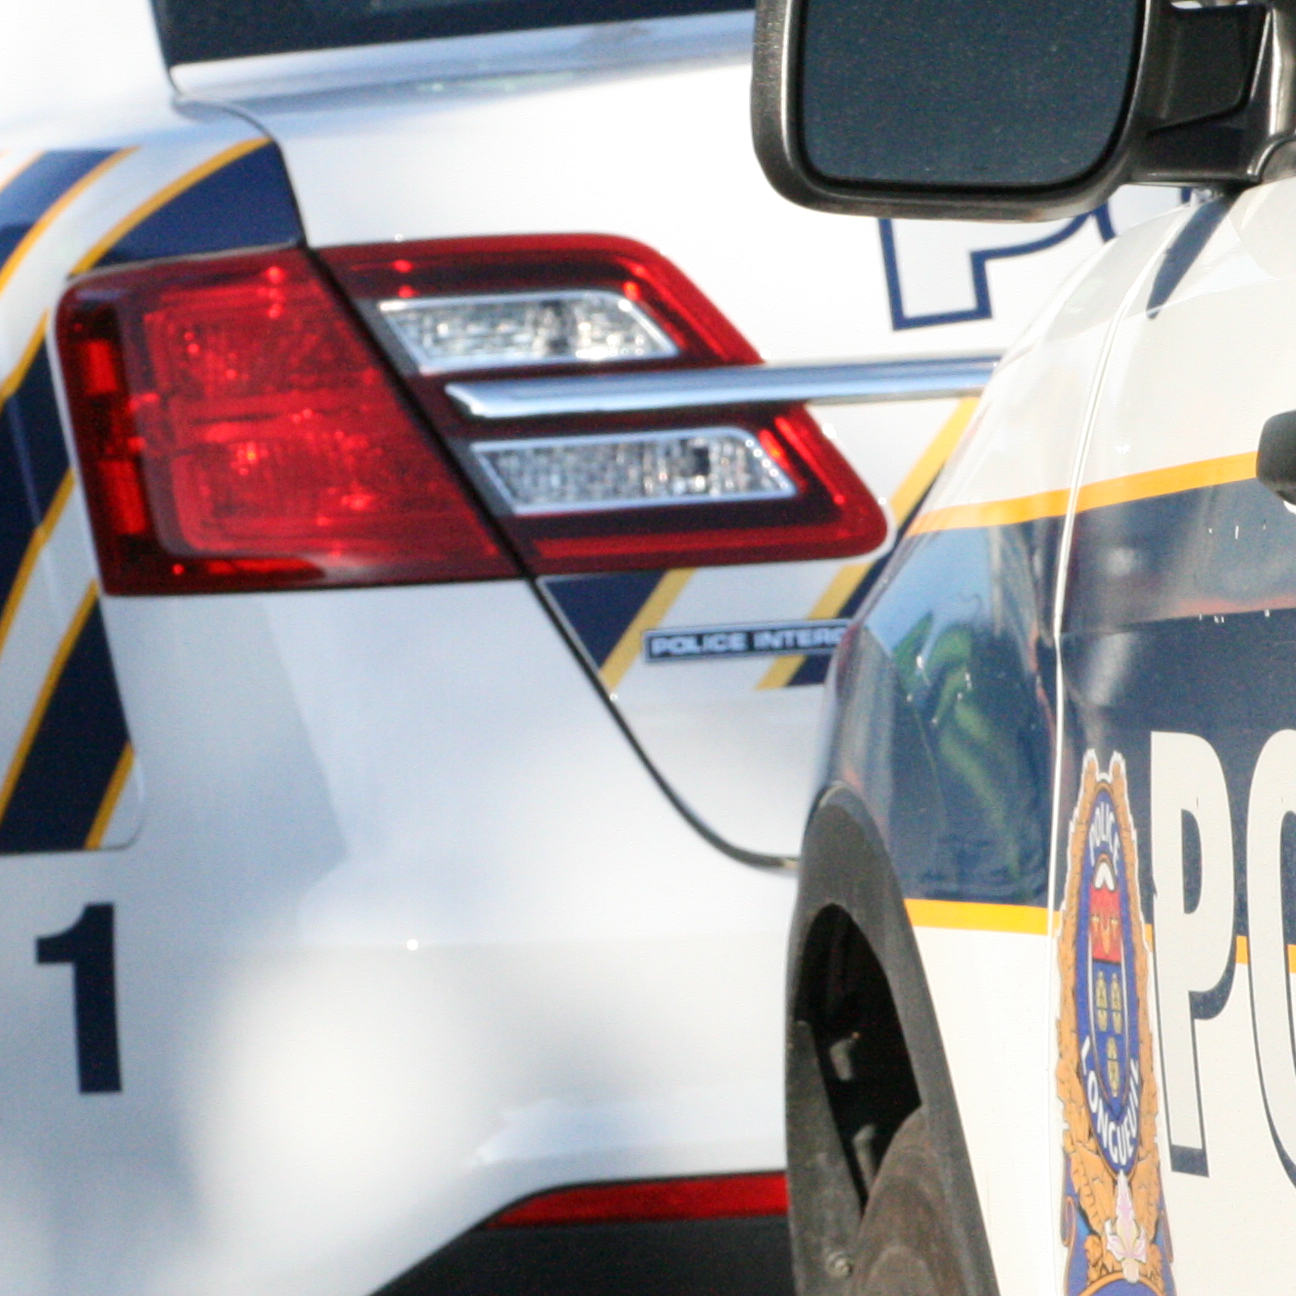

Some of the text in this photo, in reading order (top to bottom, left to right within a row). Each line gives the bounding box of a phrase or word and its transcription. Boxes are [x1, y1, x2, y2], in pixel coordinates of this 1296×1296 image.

[651, 632, 747, 655] POLICE
[1089, 801, 1121, 875] POLICE
[1081, 1037, 1139, 1166] LONGUEUIL
